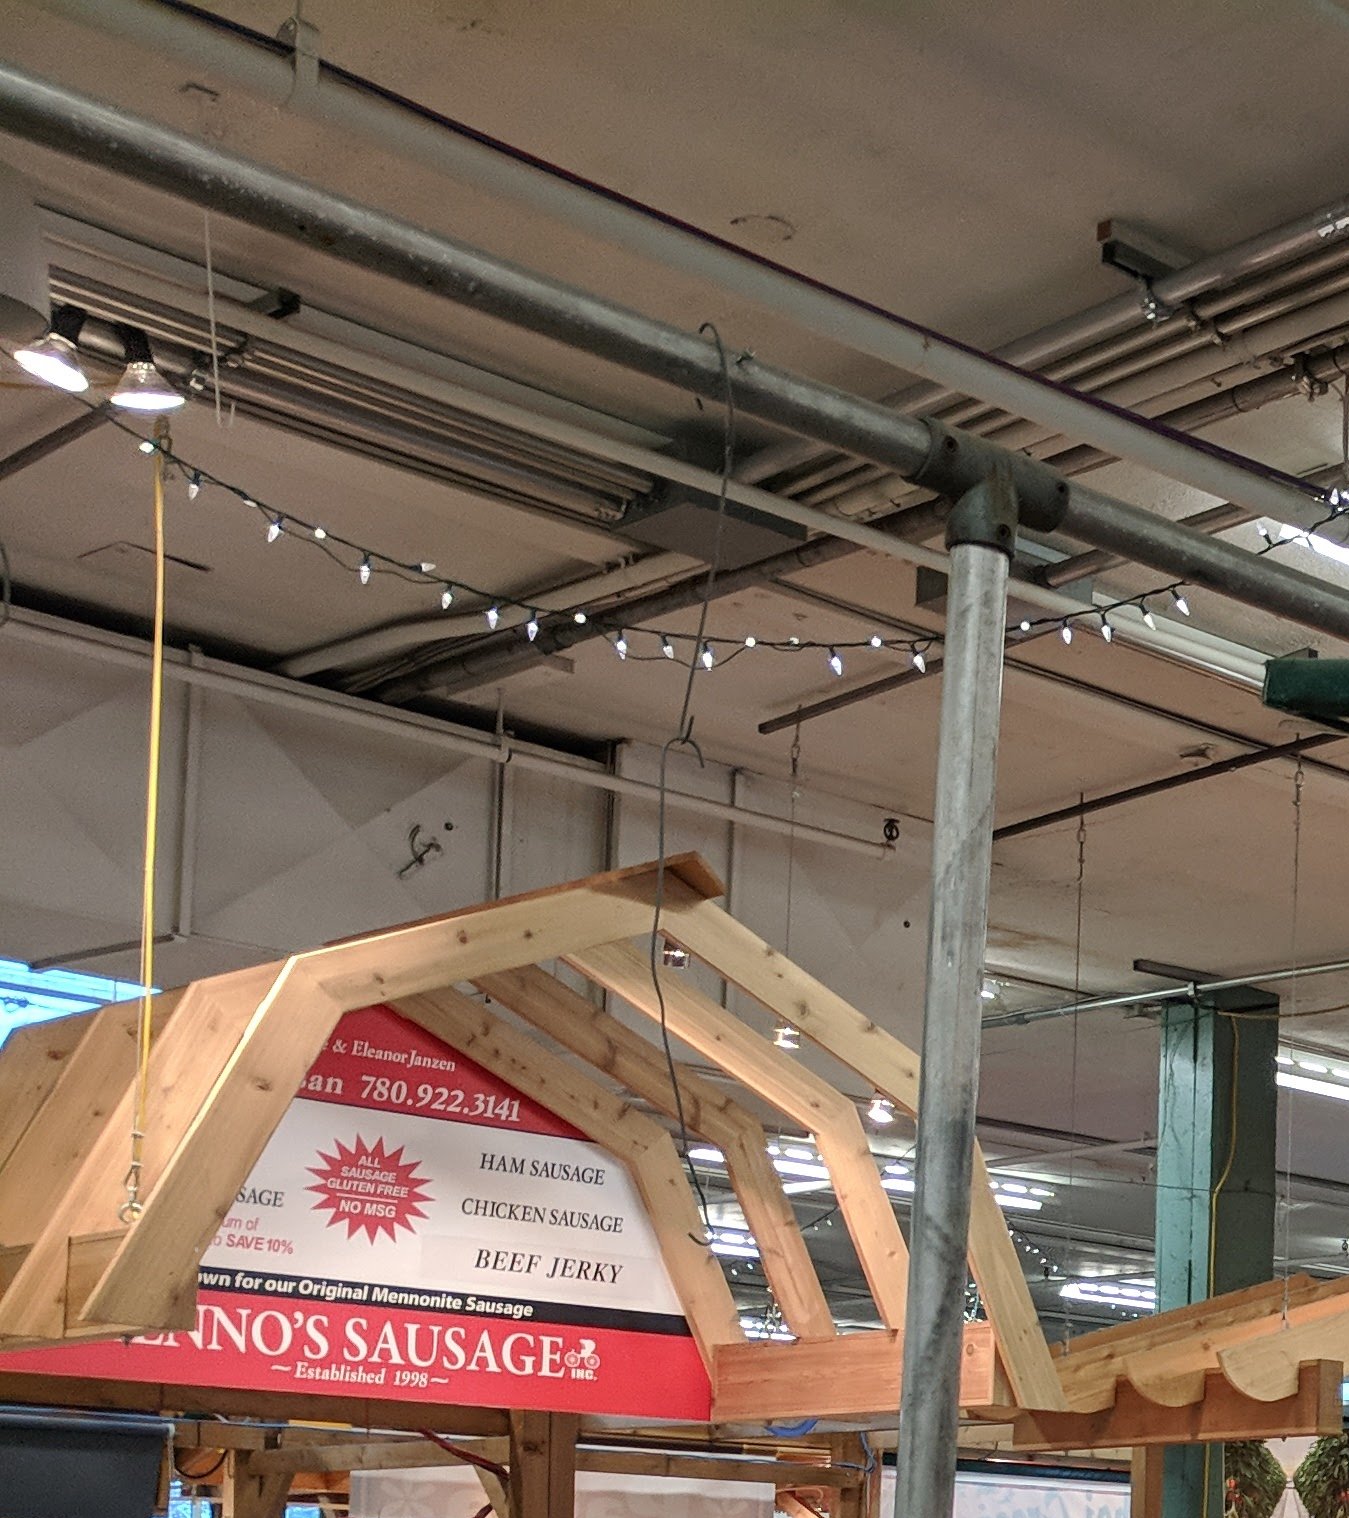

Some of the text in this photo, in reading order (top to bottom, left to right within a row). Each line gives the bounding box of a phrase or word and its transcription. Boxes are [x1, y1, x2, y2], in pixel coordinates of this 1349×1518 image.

[332, 1039, 456, 1072] & Eleanor Janzen
[361, 1074, 521, 1122] 780.922.3141
[340, 1156, 397, 1184] ALL SAUSAGE
[480, 1153, 606, 1186] HAM SAUSAGE
[327, 1178, 409, 1198] GLUTEN FREE
[246, 1218, 260, 1231] of
[339, 1200, 396, 1218] NO MSG
[462, 1198, 624, 1234] CHICKEN SAUSAGE
[226, 1234, 264, 1251] SAVE
[267, 1239, 294, 1255] 10%
[475, 1249, 623, 1284] BEEF JERKY
[234, 1272, 262, 1289] for
[265, 1279, 296, 1294] our
[298, 1280, 369, 1301] Original
[372, 1287, 462, 1310] Mennonite
[465, 1296, 534, 1319] Sausage
[343, 1318, 566, 1379] SAUSAGE
[295, 1361, 429, 1388] Established 1998
